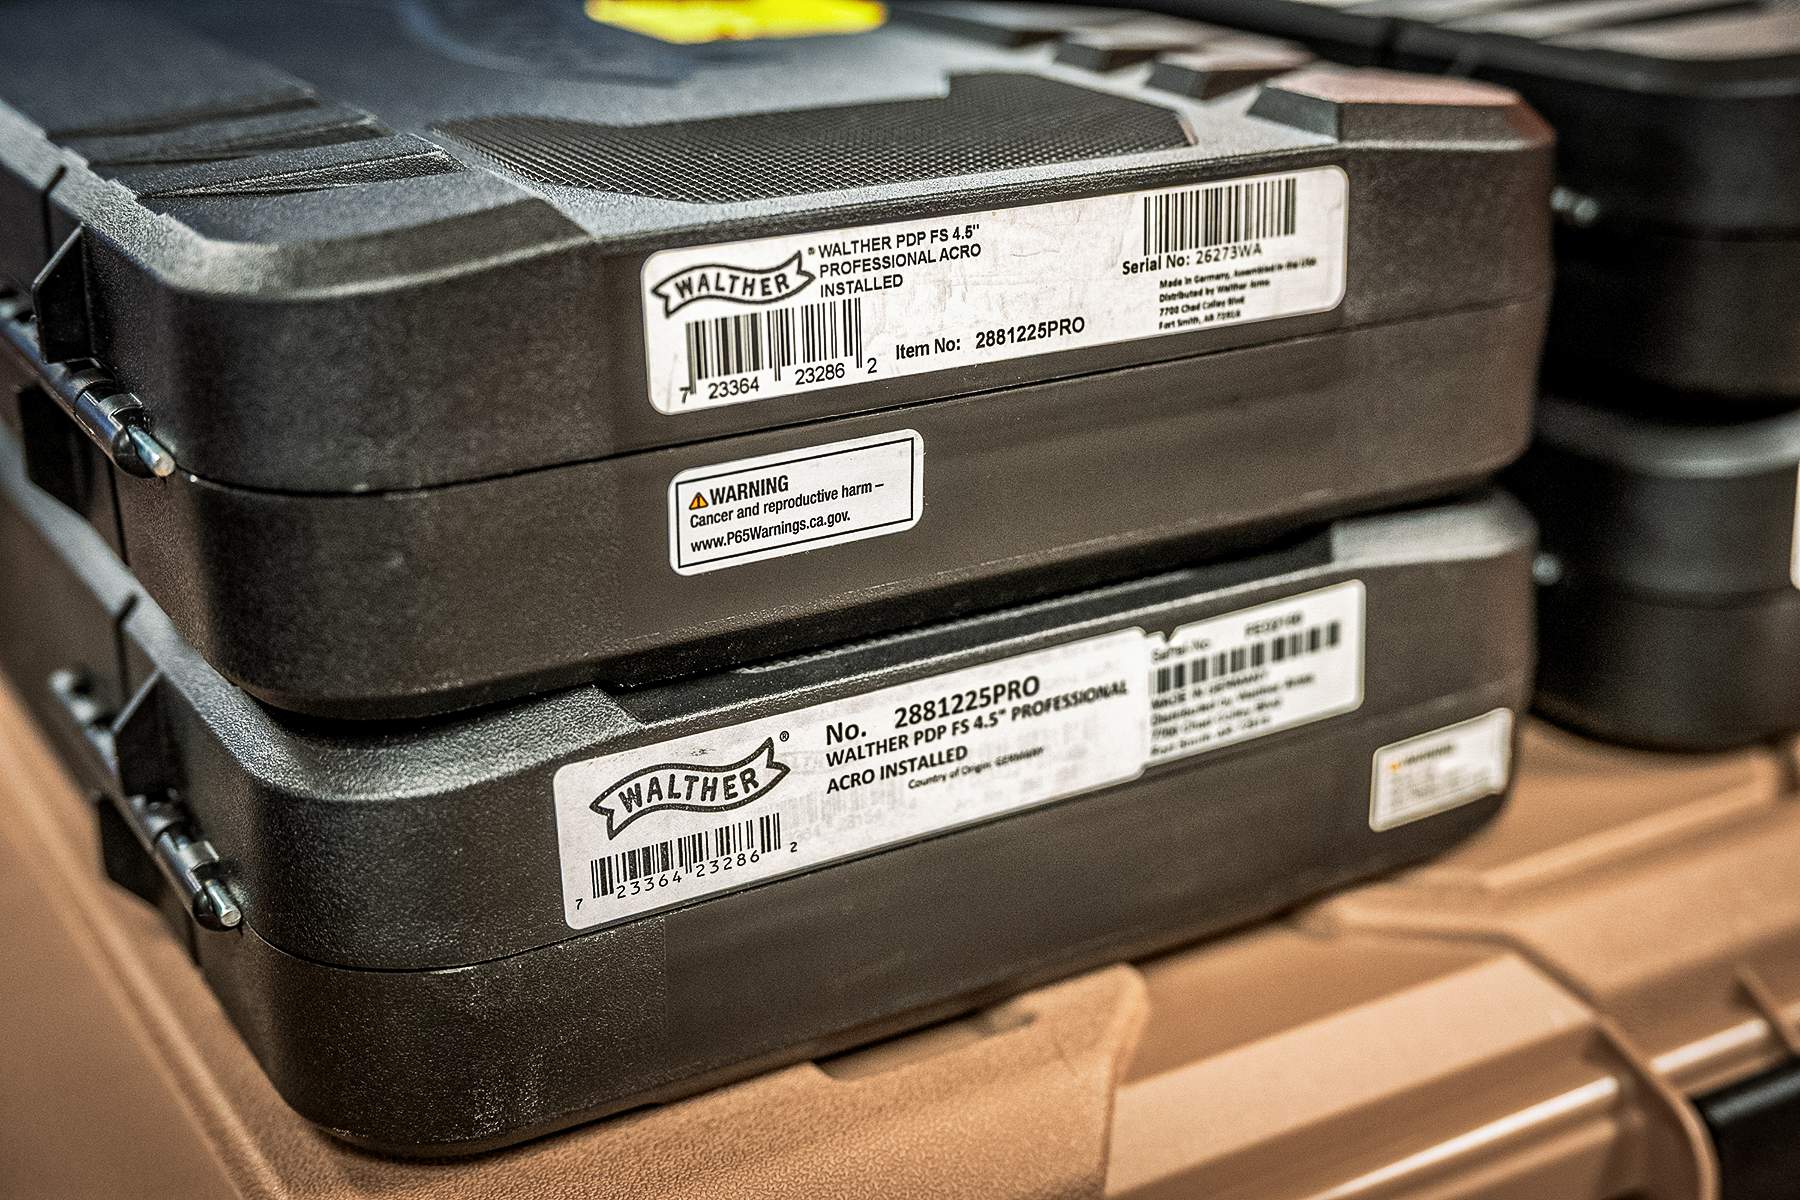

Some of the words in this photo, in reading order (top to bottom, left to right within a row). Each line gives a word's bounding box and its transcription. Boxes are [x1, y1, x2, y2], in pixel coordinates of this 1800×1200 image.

[818, 235, 892, 258] WALTHER
[896, 230, 926, 249] PDP
[930, 227, 949, 244] FS
[819, 251, 937, 278] PROFESSIONAL
[939, 243, 982, 262] ACRO
[674, 271, 790, 299] WALTHER
[820, 273, 904, 298] INSTALLED
[1122, 255, 1162, 276] Serial
[1166, 253, 1191, 269] No:
[895, 343, 930, 360] Item
[934, 337, 961, 354] No:
[975, 316, 1085, 350] 2881225PRO
[679, 386, 690, 404] 7
[707, 376, 760, 400] 23364
[794, 362, 846, 386] 23286
[866, 357, 878, 375] 2
[689, 508, 734, 529] Cancer
[736, 500, 760, 520] and
[762, 486, 840, 518] reproductive
[841, 481, 873, 500] harm
[709, 474, 790, 506] WARNING
[690, 510, 851, 553] www.P65Warnings.ca.gov.
[825, 720, 867, 746] No.
[894, 675, 1040, 729] 2881225PRO
[825, 734, 910, 768] WALTHER
[913, 724, 948, 748] PDP
[951, 717, 970, 737] FS
[973, 708, 1006, 730] 4.5"
[1010, 679, 1128, 722] PROFESSIONAL
[617, 766, 760, 814] WALTHER
[826, 768, 875, 795] ACRO
[879, 744, 969, 780] INSTALLED
[907, 768, 947, 790] Country
[575, 898, 584, 911] 7
[615, 872, 683, 900] 23364
[695, 849, 761, 878] 23286
[789, 841, 799, 853] 2
